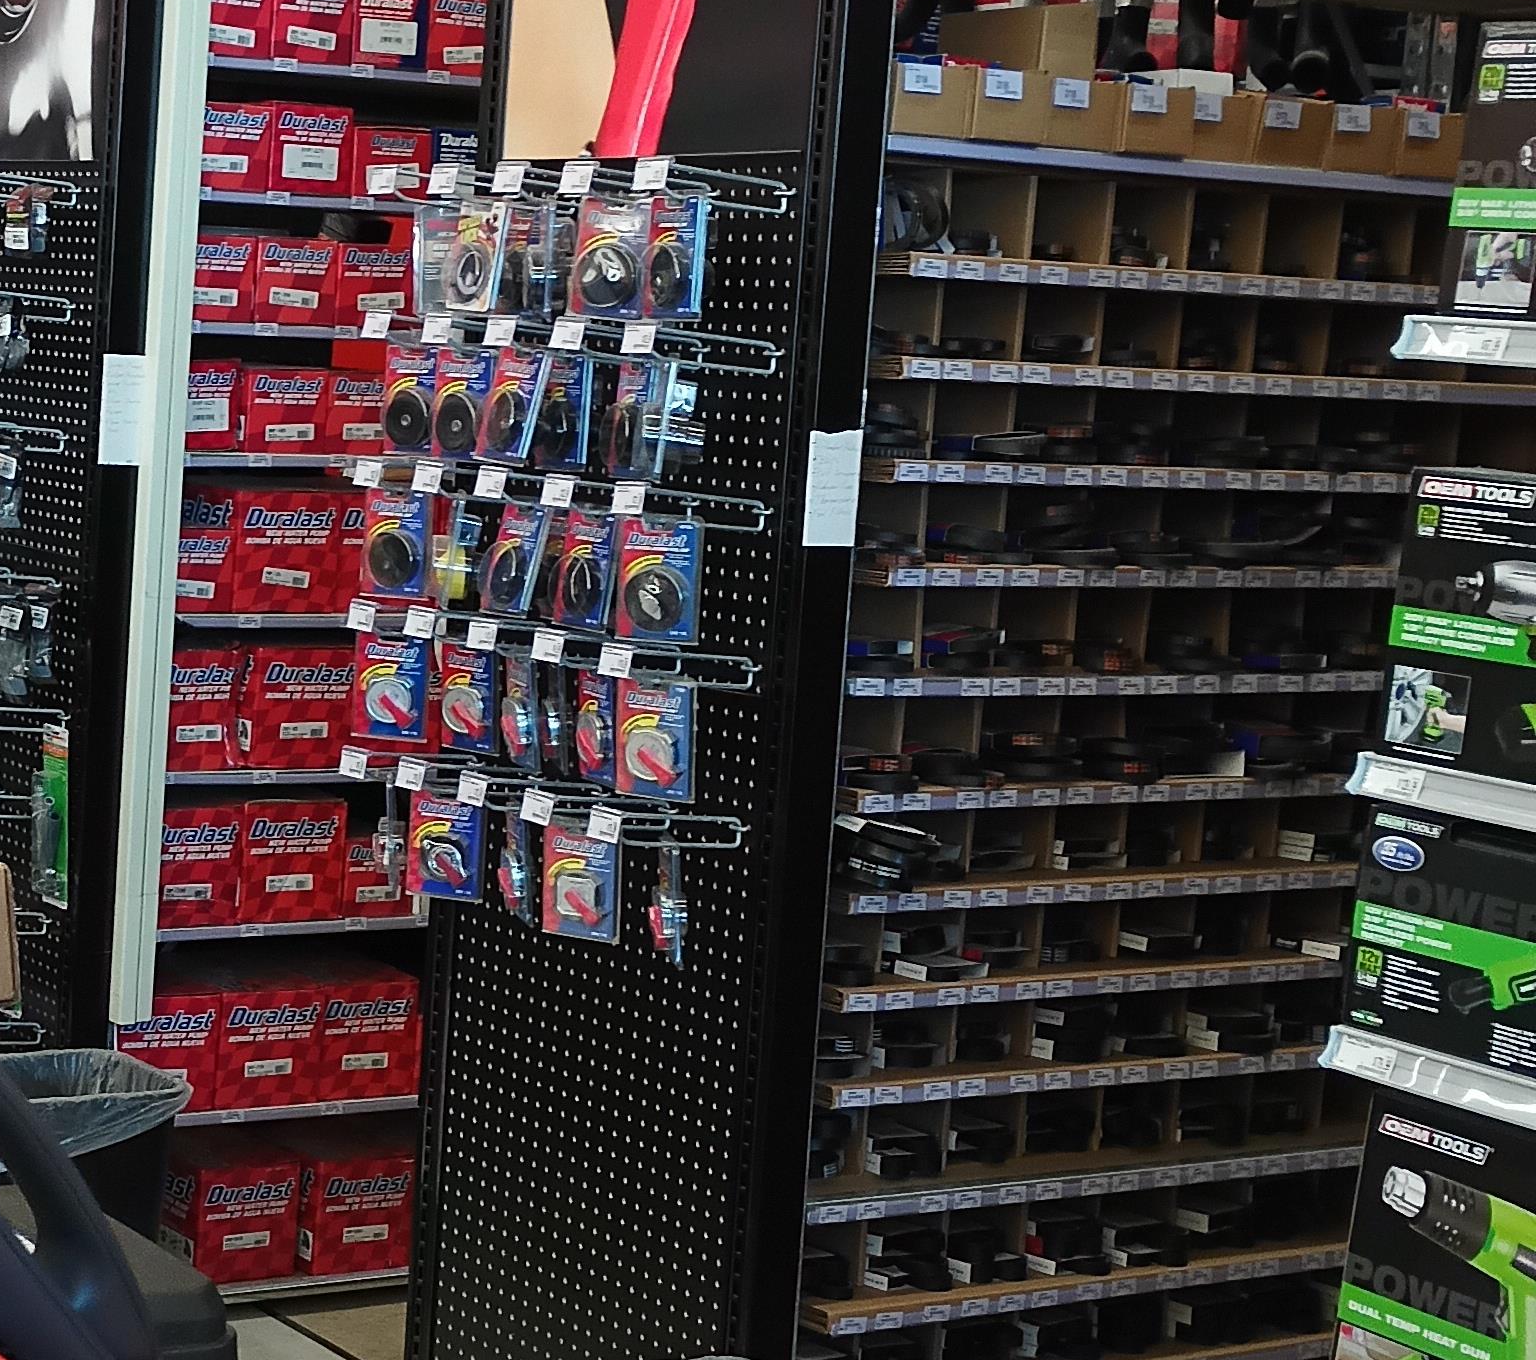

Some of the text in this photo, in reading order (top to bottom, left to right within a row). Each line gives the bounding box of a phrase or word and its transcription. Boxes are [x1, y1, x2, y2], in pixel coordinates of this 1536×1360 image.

[204, 107, 268, 128] uralast
[279, 111, 349, 132] Duralast
[197, 242, 252, 260] uralast
[264, 243, 333, 262] Duralast
[344, 248, 410, 266] Duralast
[255, 375, 324, 393] Duralast
[335, 377, 383, 394] Durala
[244, 506, 337, 531] Duralast
[627, 533, 688, 549] Duralast
[365, 643, 420, 661] Duralast
[264, 662, 357, 685] Duralast
[625, 691, 682, 709] Duralast
[417, 801, 474, 817] Duralast
[250, 815, 340, 840] Duralast
[552, 835, 609, 855] Duralast
[227, 1003, 320, 1028] Duralast
[325, 997, 414, 1021] Duralast
[204, 1178, 296, 1207] Duralast
[324, 1170, 412, 1199] Duralast
[1347, 1298, 1382, 1321] DUAL
